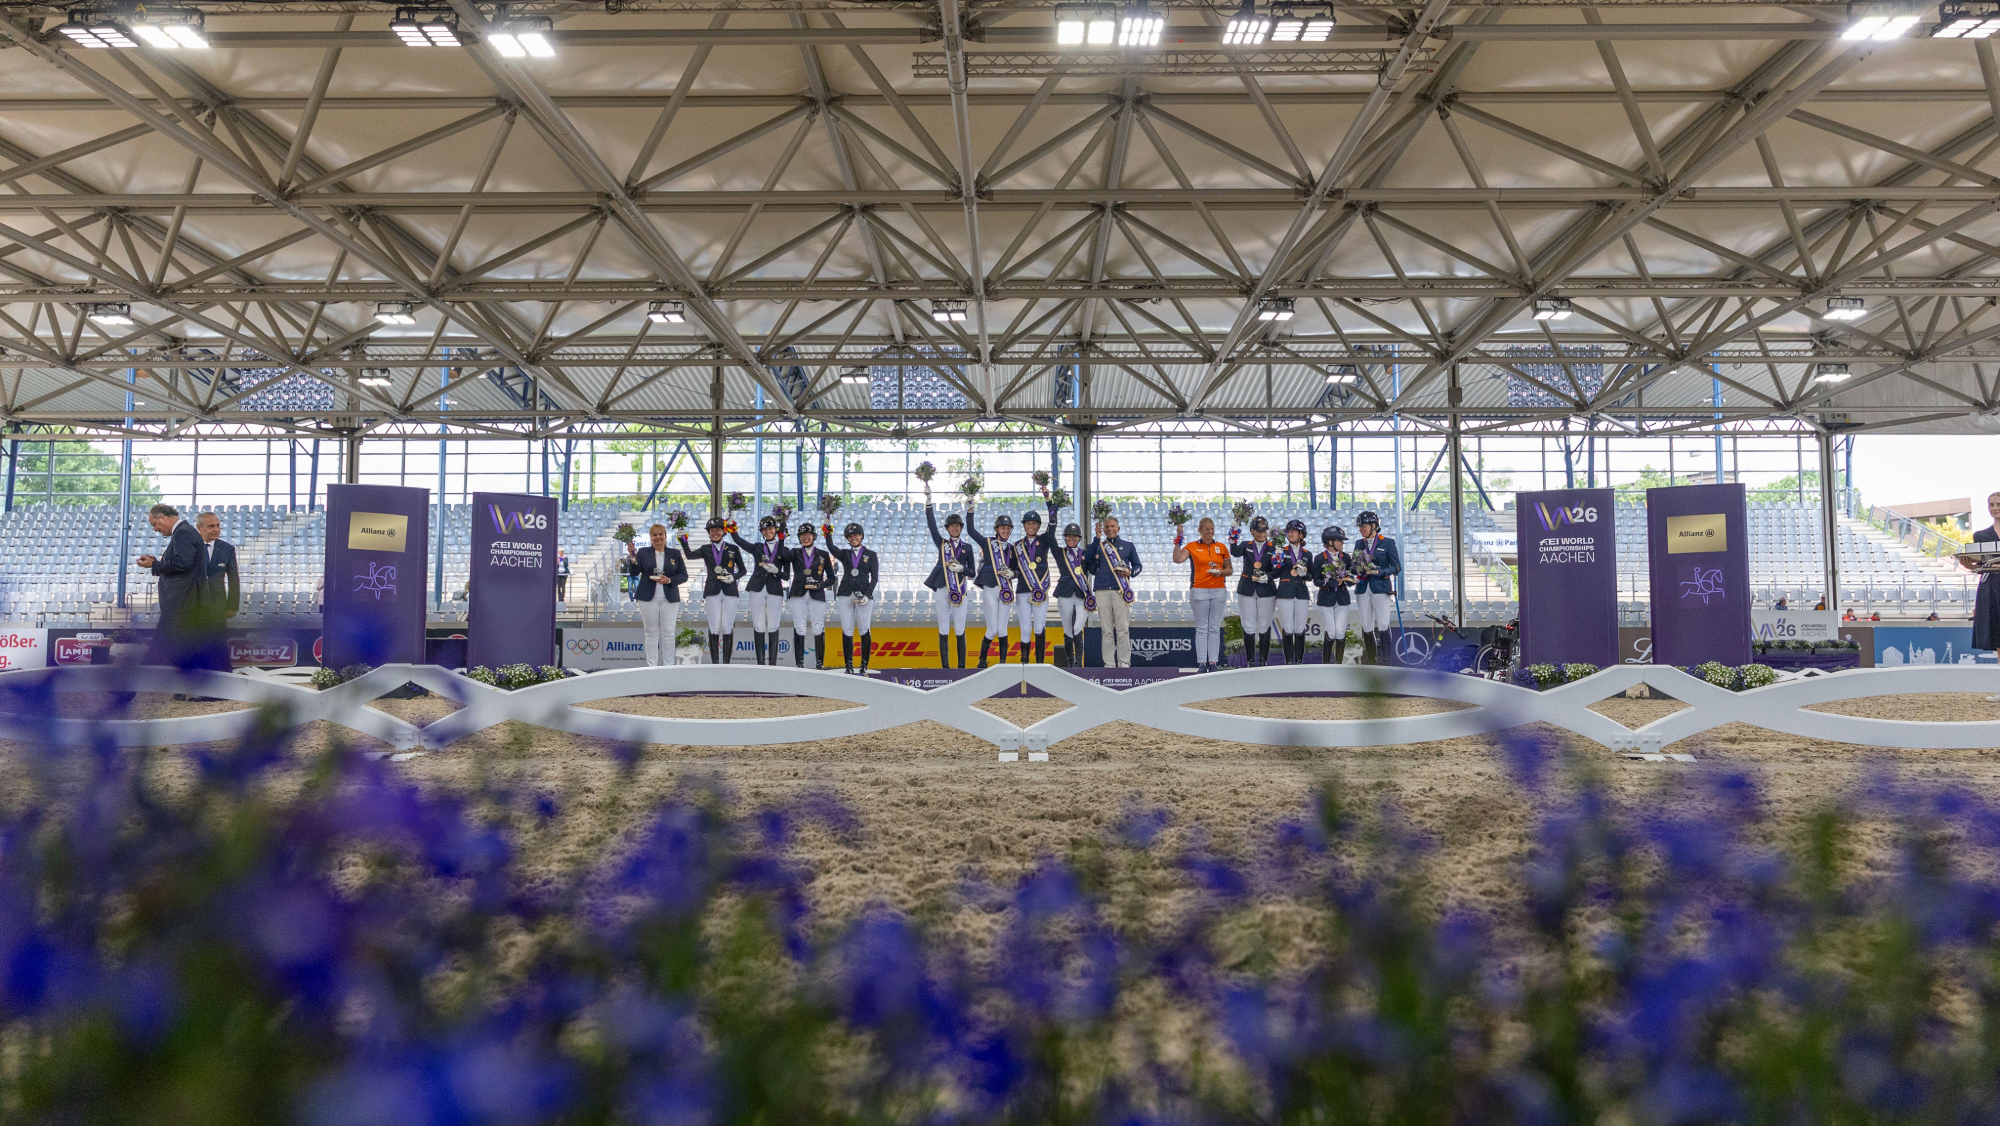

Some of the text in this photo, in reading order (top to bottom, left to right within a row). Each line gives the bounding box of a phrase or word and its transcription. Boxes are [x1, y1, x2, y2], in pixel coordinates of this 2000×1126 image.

[361, 527, 386, 535] Allianz
[1561, 537, 1595, 545] WORLD
[512, 542, 543, 550] WORLD
[490, 548, 543, 557] CHAMPIONSHIPS
[490, 555, 543, 568] AACHEN
[1540, 552, 1595, 564] AACHEN
[606, 642, 644, 651] Allianz
[851, 642, 925, 656] DHL
[231, 646, 291, 659] LAMBERTZ
